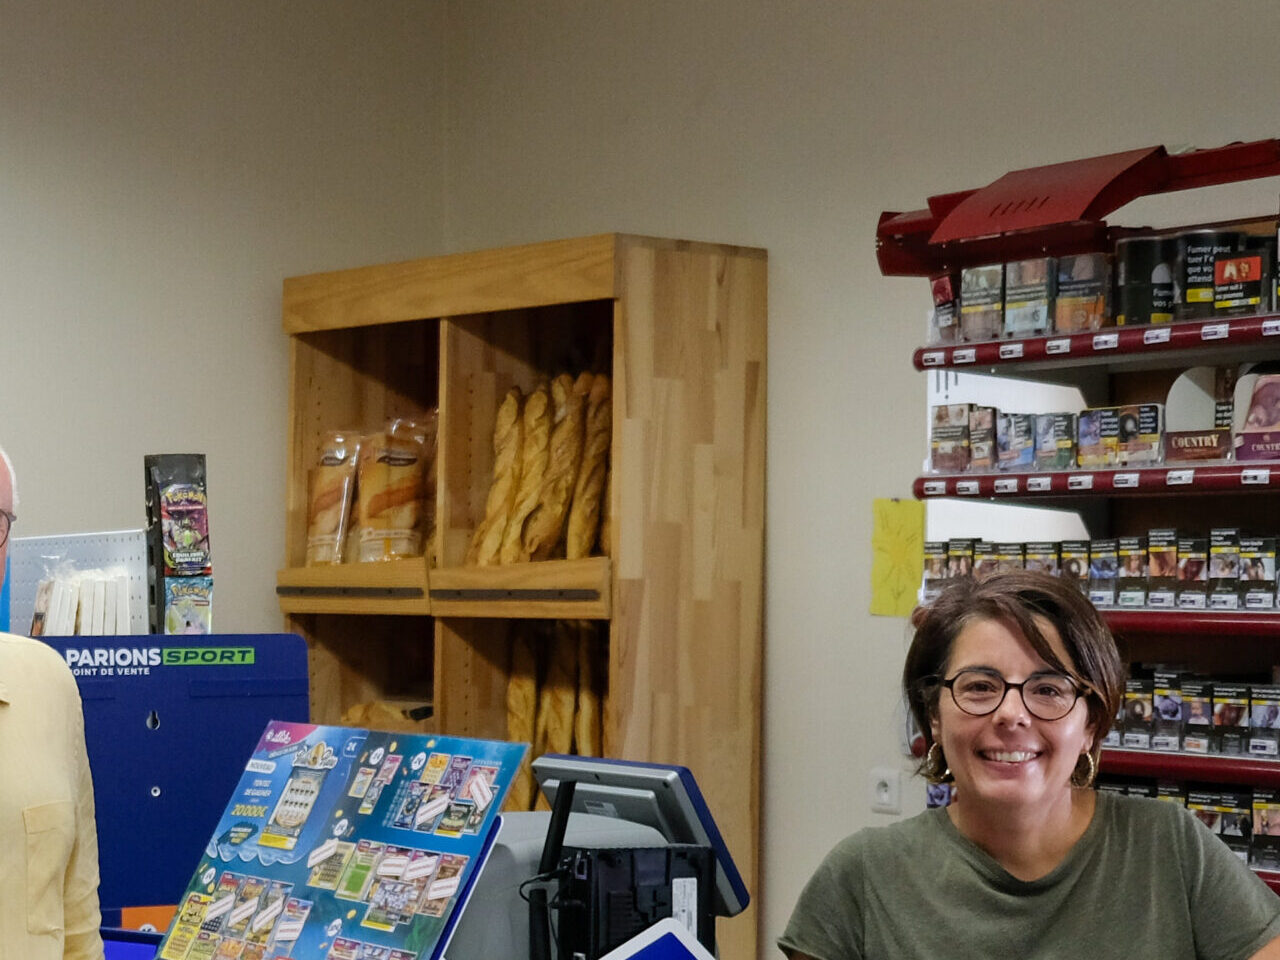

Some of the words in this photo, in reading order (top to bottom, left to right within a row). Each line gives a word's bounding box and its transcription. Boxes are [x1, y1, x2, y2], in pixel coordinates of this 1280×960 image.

[1171, 434, 1219, 448] COUNTRY
[66, 648, 161, 667] PARIONS
[166, 650, 252, 663] SPORT
[100, 667, 114, 676] DE
[117, 667, 151, 676] VENTE
